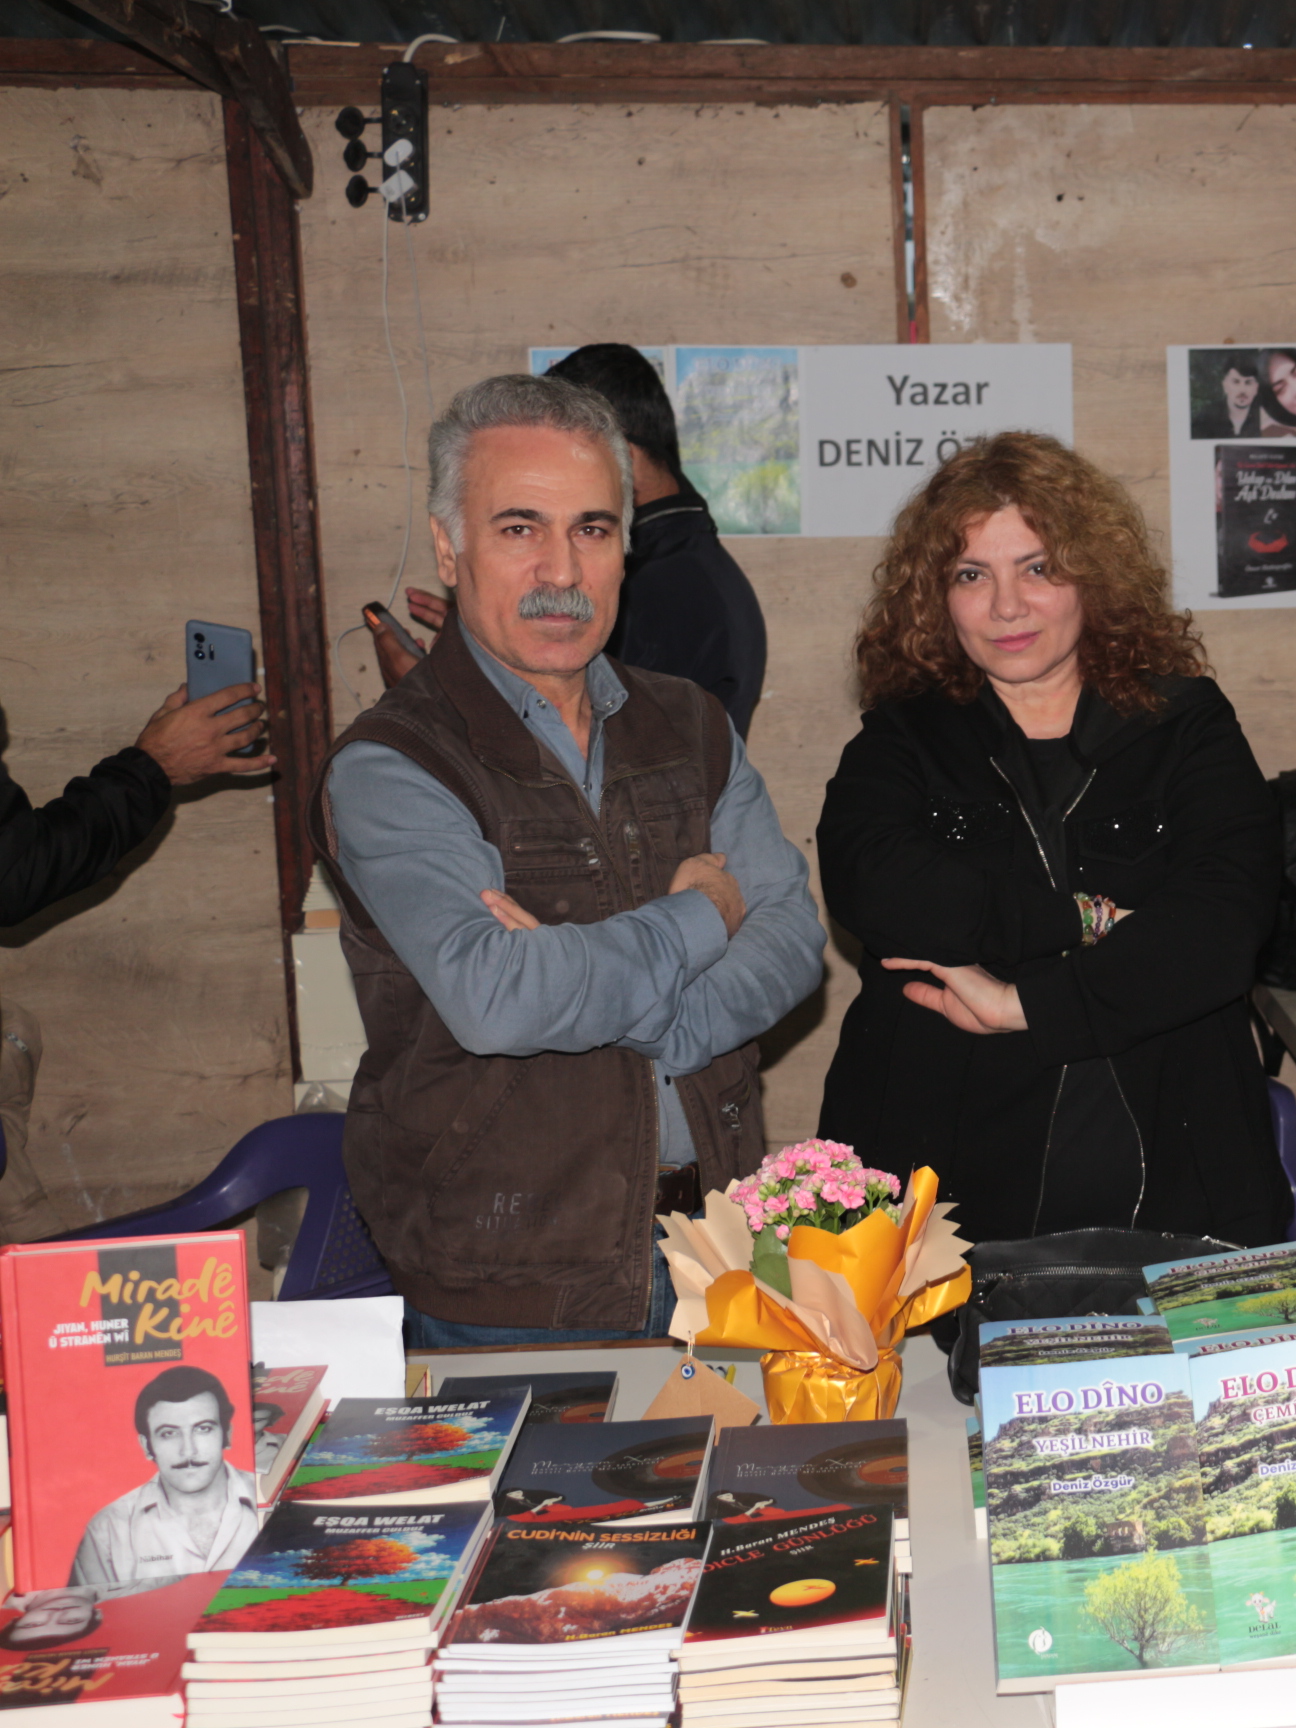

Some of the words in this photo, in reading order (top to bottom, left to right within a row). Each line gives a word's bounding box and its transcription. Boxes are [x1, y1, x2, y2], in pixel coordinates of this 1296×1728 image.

[887, 375, 990, 406] Yazar
[818, 431, 924, 467] DENİZ
[79, 1257, 236, 1308] Miradê
[53, 1321, 89, 1335] JIYAN,
[91, 1318, 129, 1331] HUNER
[134, 1300, 238, 1345] Kinê
[1008, 1324, 1062, 1335] ELO
[60, 1332, 111, 1348] STRANÊN
[131, 1350, 154, 1361] BARAN
[154, 1349, 182, 1360] MENDEŞ
[1220, 1371, 1279, 1400] ELO
[1015, 1390, 1074, 1415] ELO
[1081, 1380, 1164, 1410] DÎNO
[428, 1401, 491, 1415] WELAT
[386, 1414, 434, 1422] MUZAFFER
[1035, 1435, 1088, 1455] YEŞİL
[1092, 1430, 1152, 1449] NEHİR
[1053, 1479, 1089, 1491] Deniz
[1093, 1476, 1133, 1490] Özgür
[313, 1516, 368, 1529] EŞQA
[373, 1514, 445, 1526] WELAT
[325, 1527, 381, 1535] MUZAFFER
[599, 1528, 696, 1543] SESSİZLİĞİ
[772, 1513, 878, 1552] GÜNLÜĞÜ
